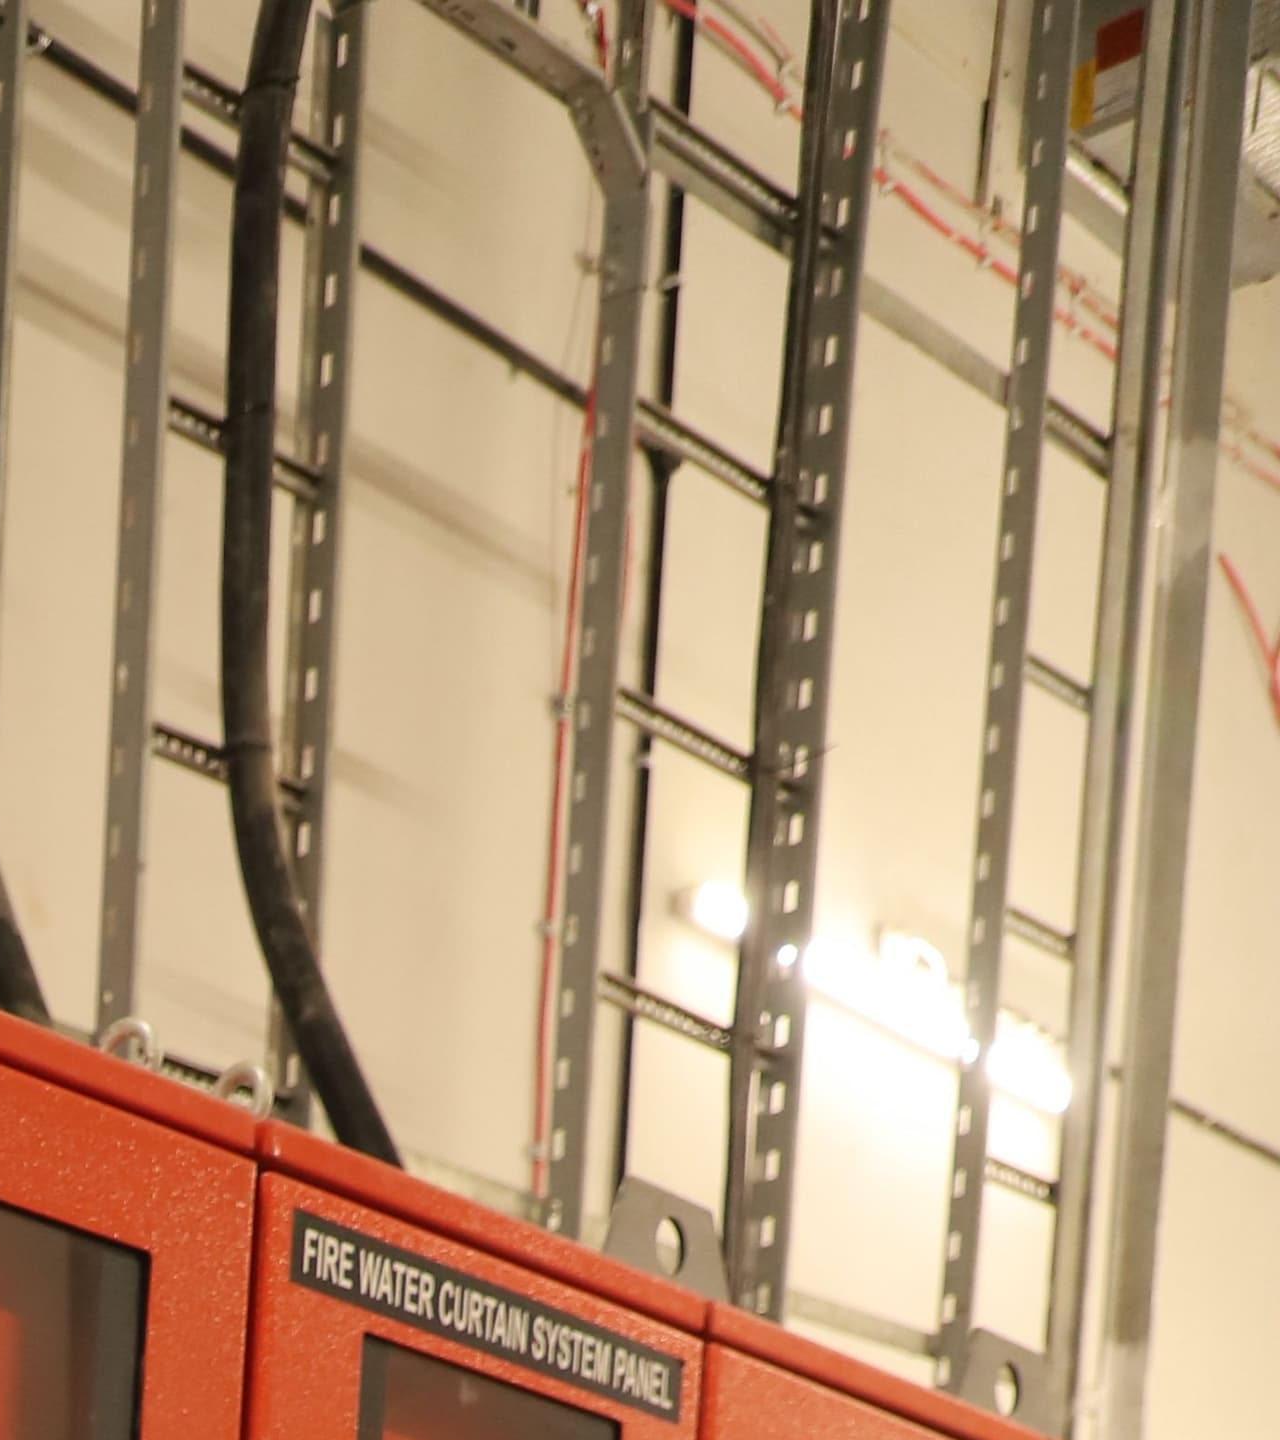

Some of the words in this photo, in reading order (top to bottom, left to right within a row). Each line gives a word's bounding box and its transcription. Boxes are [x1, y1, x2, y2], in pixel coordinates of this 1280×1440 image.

[301, 1227, 354, 1289] FIRE
[359, 1248, 434, 1321] WATER
[438, 1280, 530, 1355] CURTAIN
[532, 1316, 615, 1386] SYSTEM
[613, 1344, 673, 1410] PANEL
